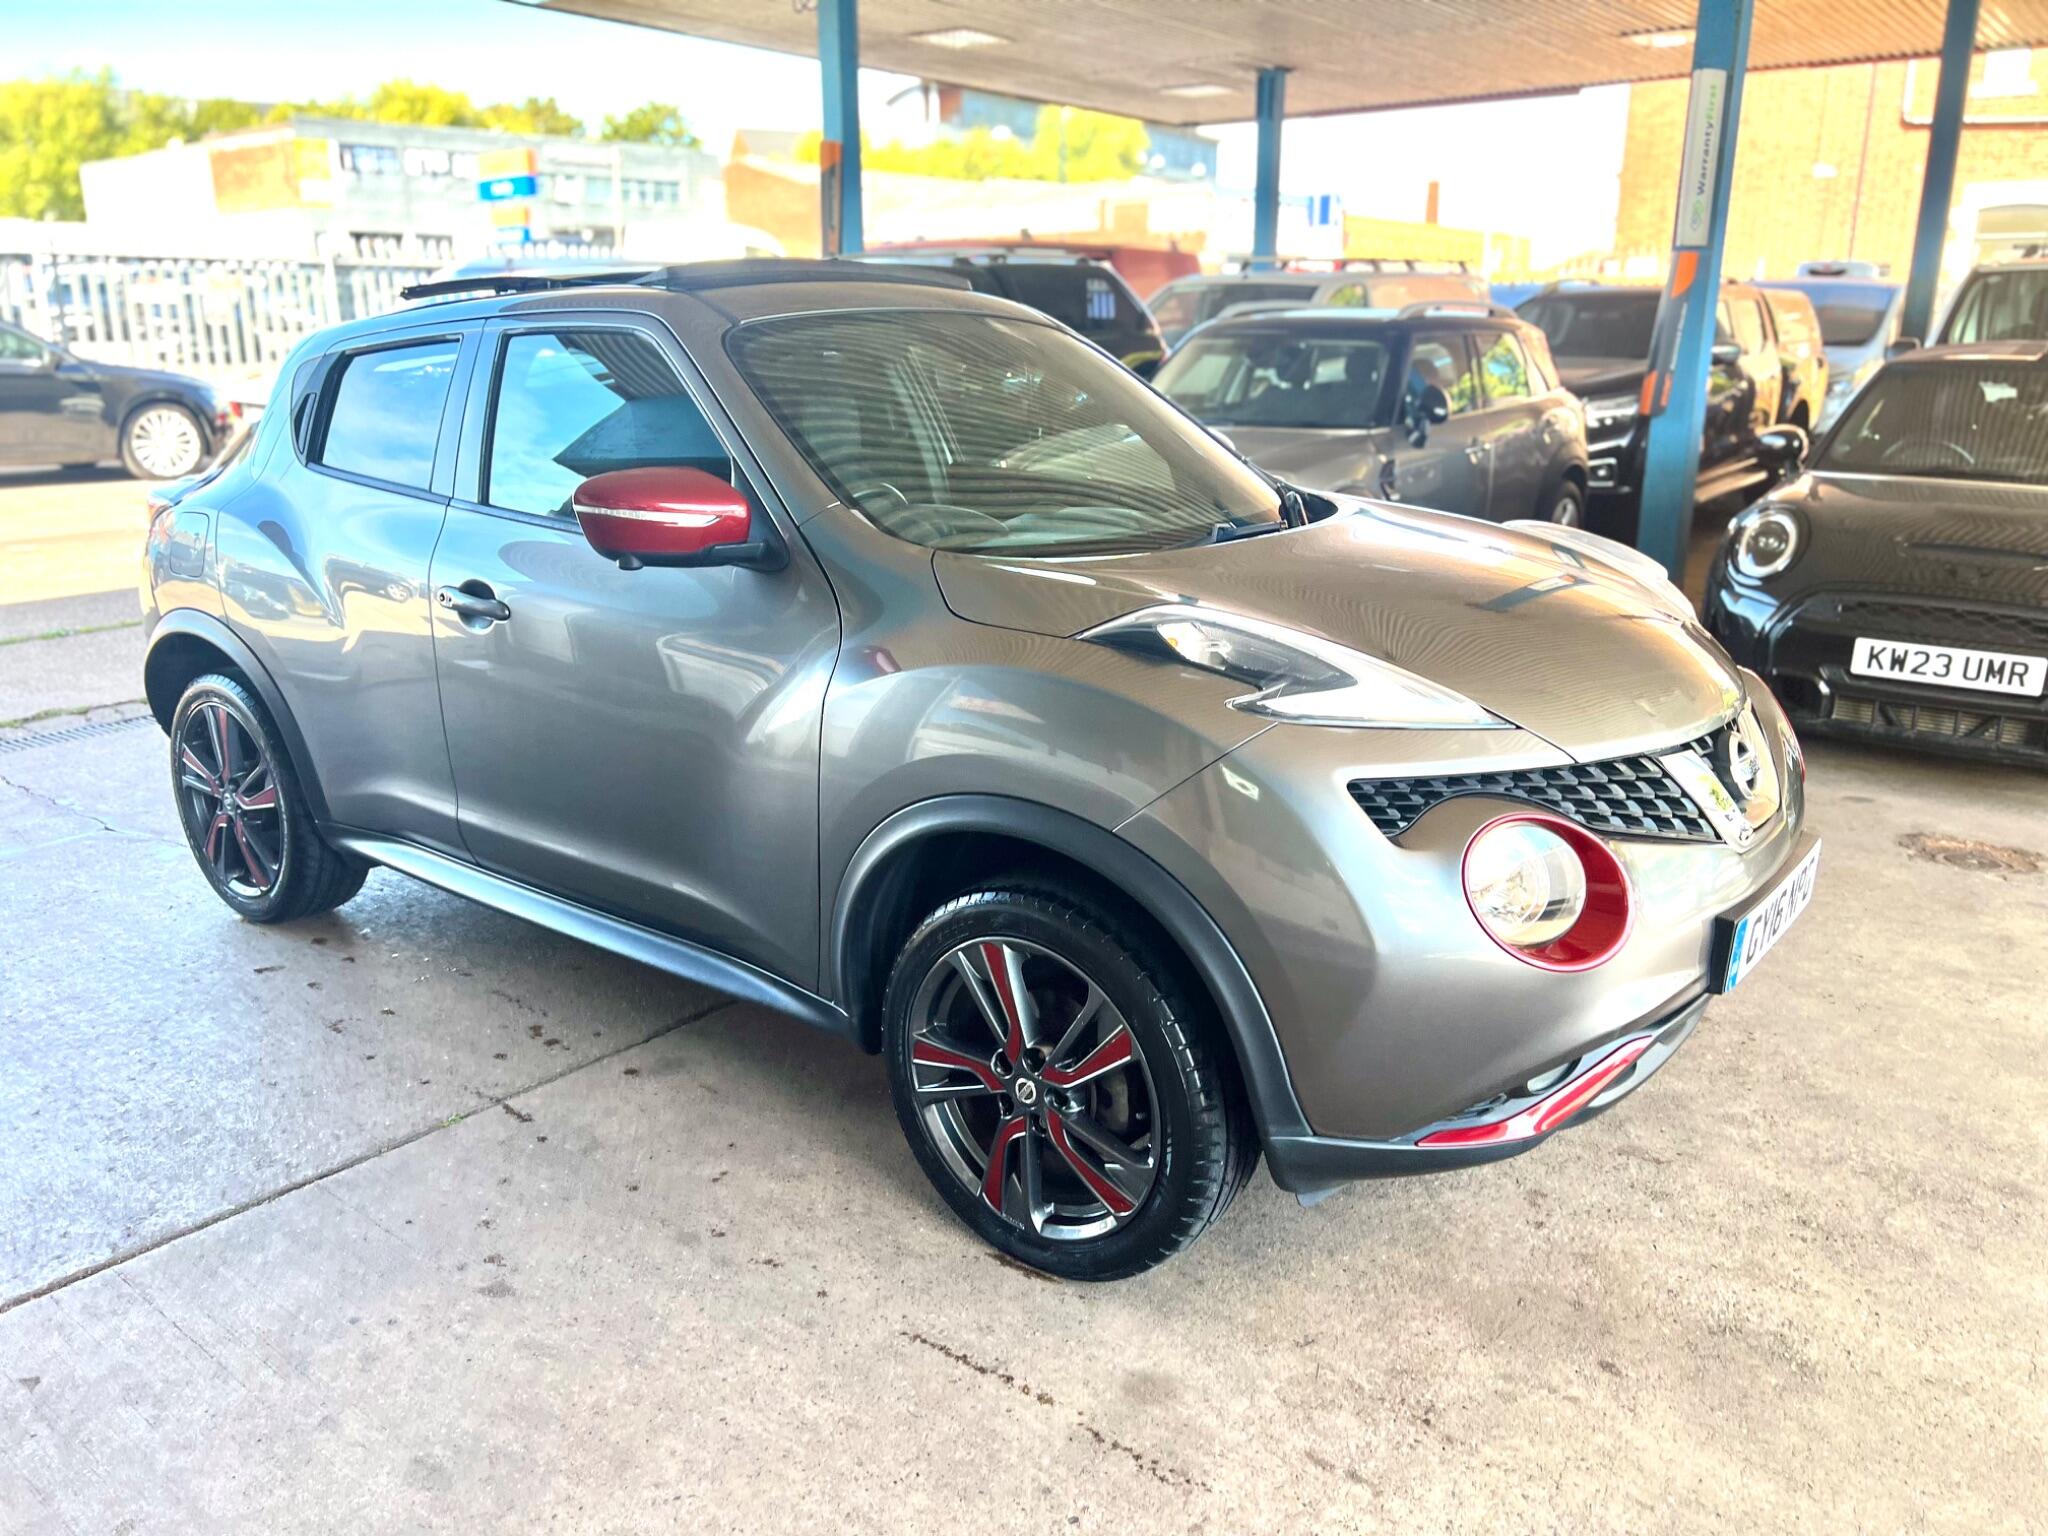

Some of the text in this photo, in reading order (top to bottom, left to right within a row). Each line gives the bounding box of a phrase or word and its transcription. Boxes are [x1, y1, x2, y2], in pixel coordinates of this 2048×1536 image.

[1696, 84, 1717, 196] WarrantyFirst
[1866, 645, 2029, 687] KW23 UMR
[1746, 888, 1787, 965] GY16
